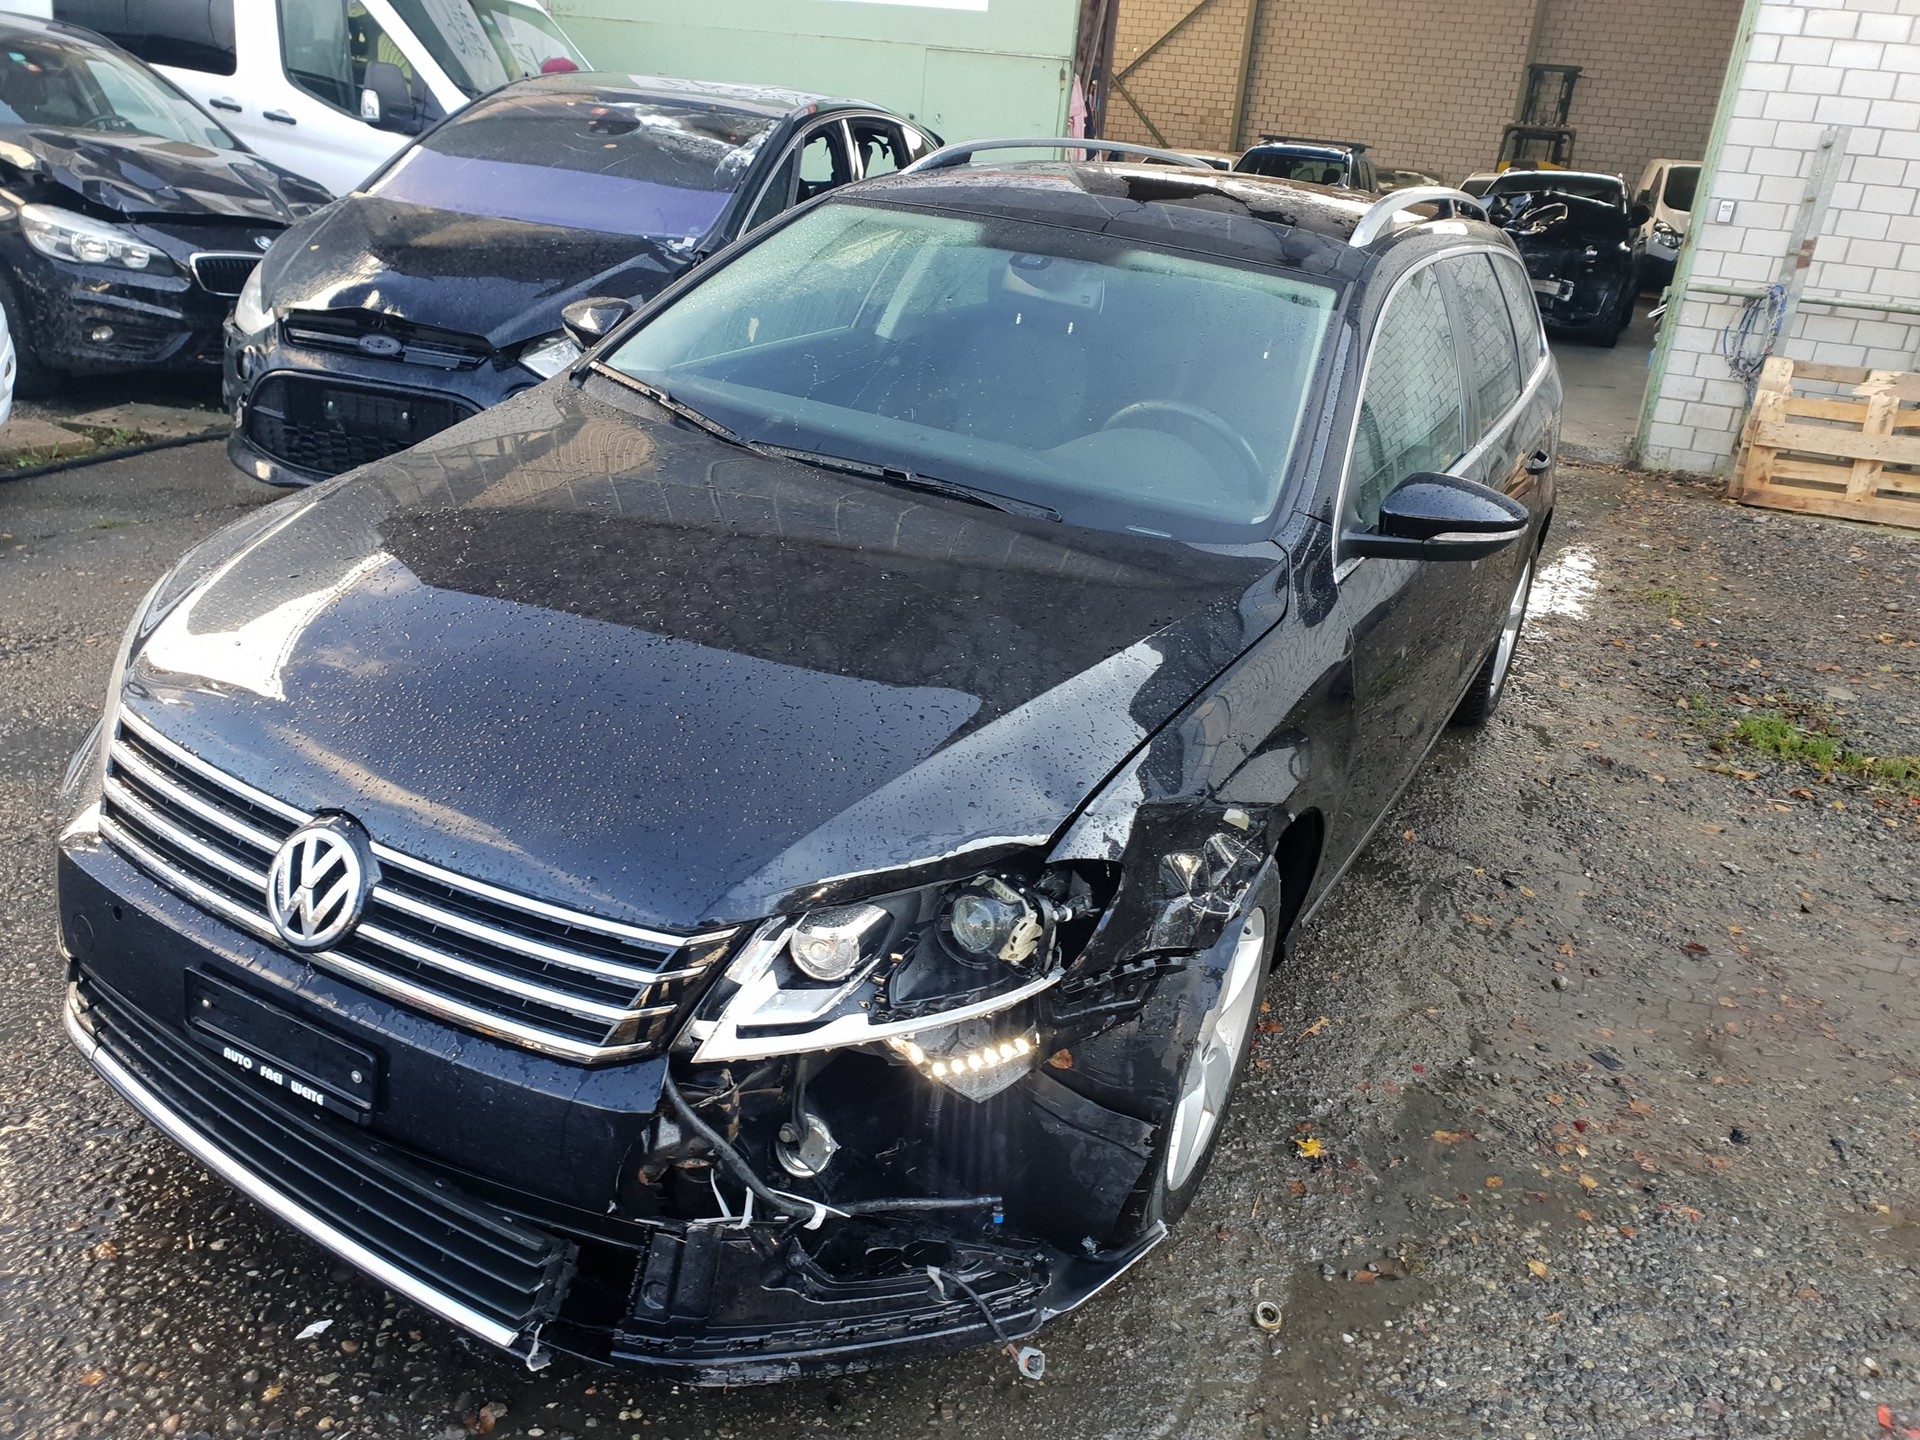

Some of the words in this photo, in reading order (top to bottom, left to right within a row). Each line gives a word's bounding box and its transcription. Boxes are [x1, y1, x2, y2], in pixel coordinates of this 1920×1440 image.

[269, 829, 360, 945] VW
[223, 1047, 252, 1069] AUTO
[260, 1065, 283, 1086] FREI
